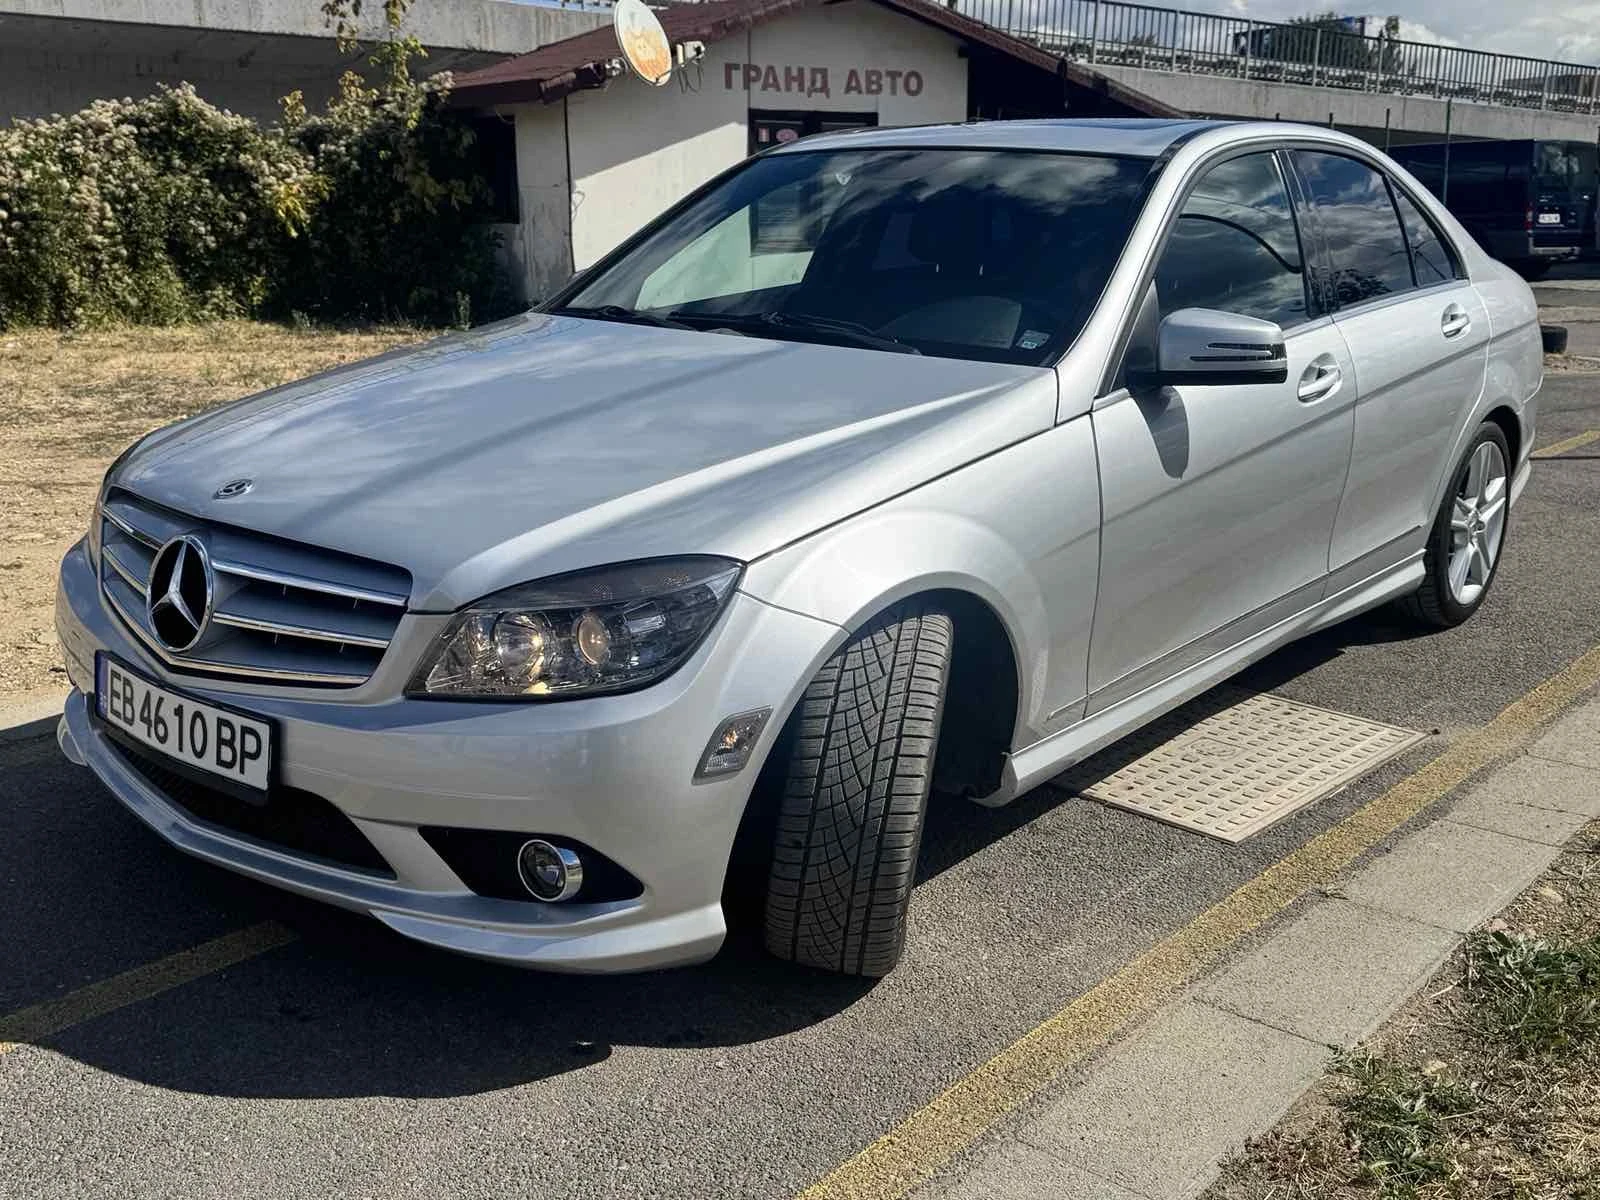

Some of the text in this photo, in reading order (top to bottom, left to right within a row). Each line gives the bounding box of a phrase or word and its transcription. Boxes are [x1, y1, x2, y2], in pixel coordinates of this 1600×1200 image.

[724, 63, 924, 99] ГРАНД АВТО
[110, 669, 262, 775] EB 4610 BP
